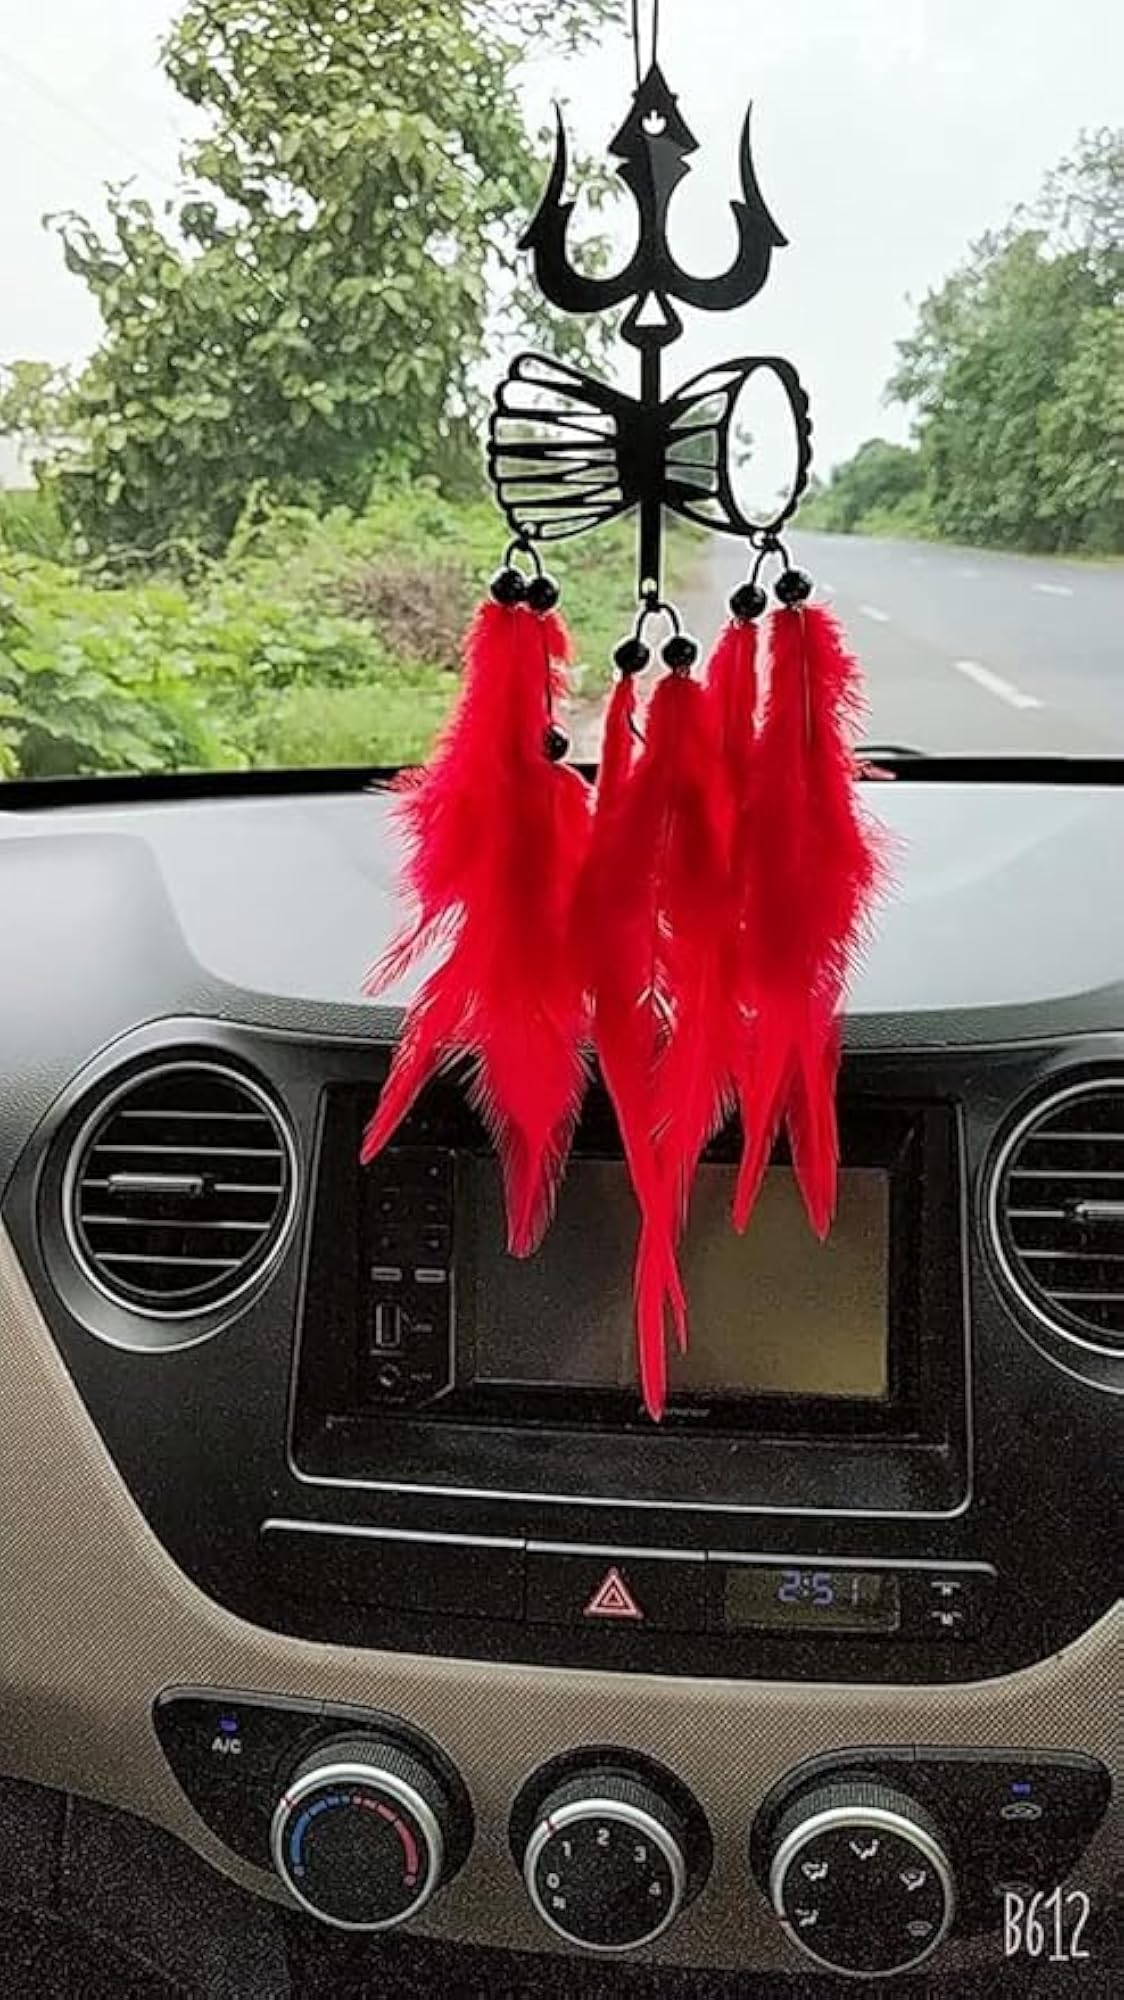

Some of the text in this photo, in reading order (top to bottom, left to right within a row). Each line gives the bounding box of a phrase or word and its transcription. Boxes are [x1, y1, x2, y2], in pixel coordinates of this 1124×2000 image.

[211, 1736, 242, 1754] A/C
[597, 1828, 610, 1846] 2
[562, 1840, 572, 1857] 1
[633, 1845, 647, 1863] 3
[649, 1881, 662, 1896] 4
